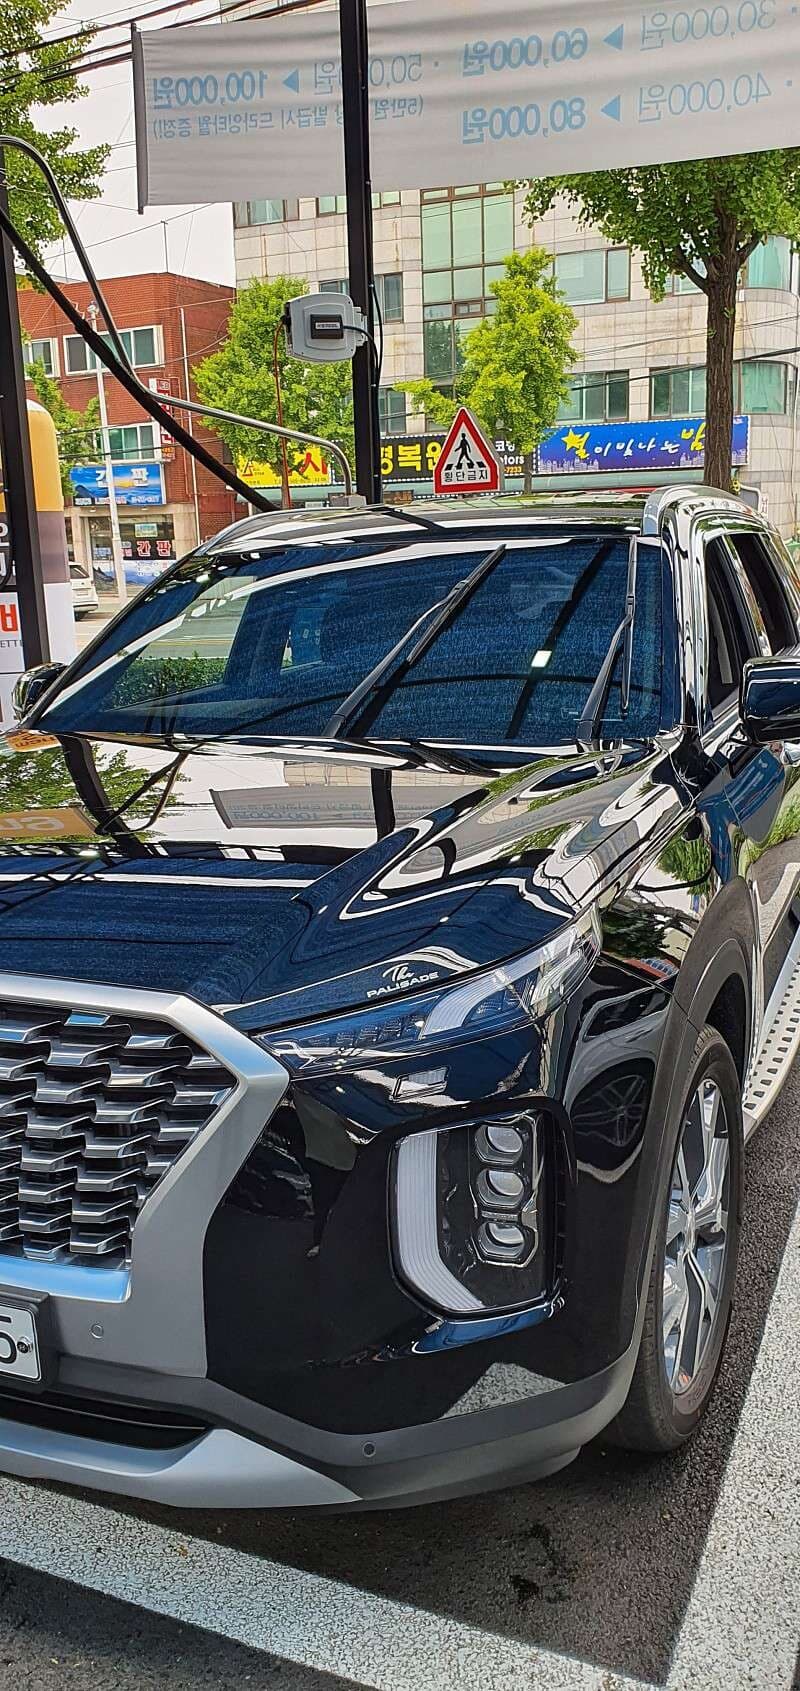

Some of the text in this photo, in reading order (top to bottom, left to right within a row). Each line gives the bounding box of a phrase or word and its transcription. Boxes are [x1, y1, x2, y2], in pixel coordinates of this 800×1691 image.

[444, 469, 488, 483] 횡단금지
[382, 962, 415, 982] The
[366, 971, 440, 998] PALISADE
